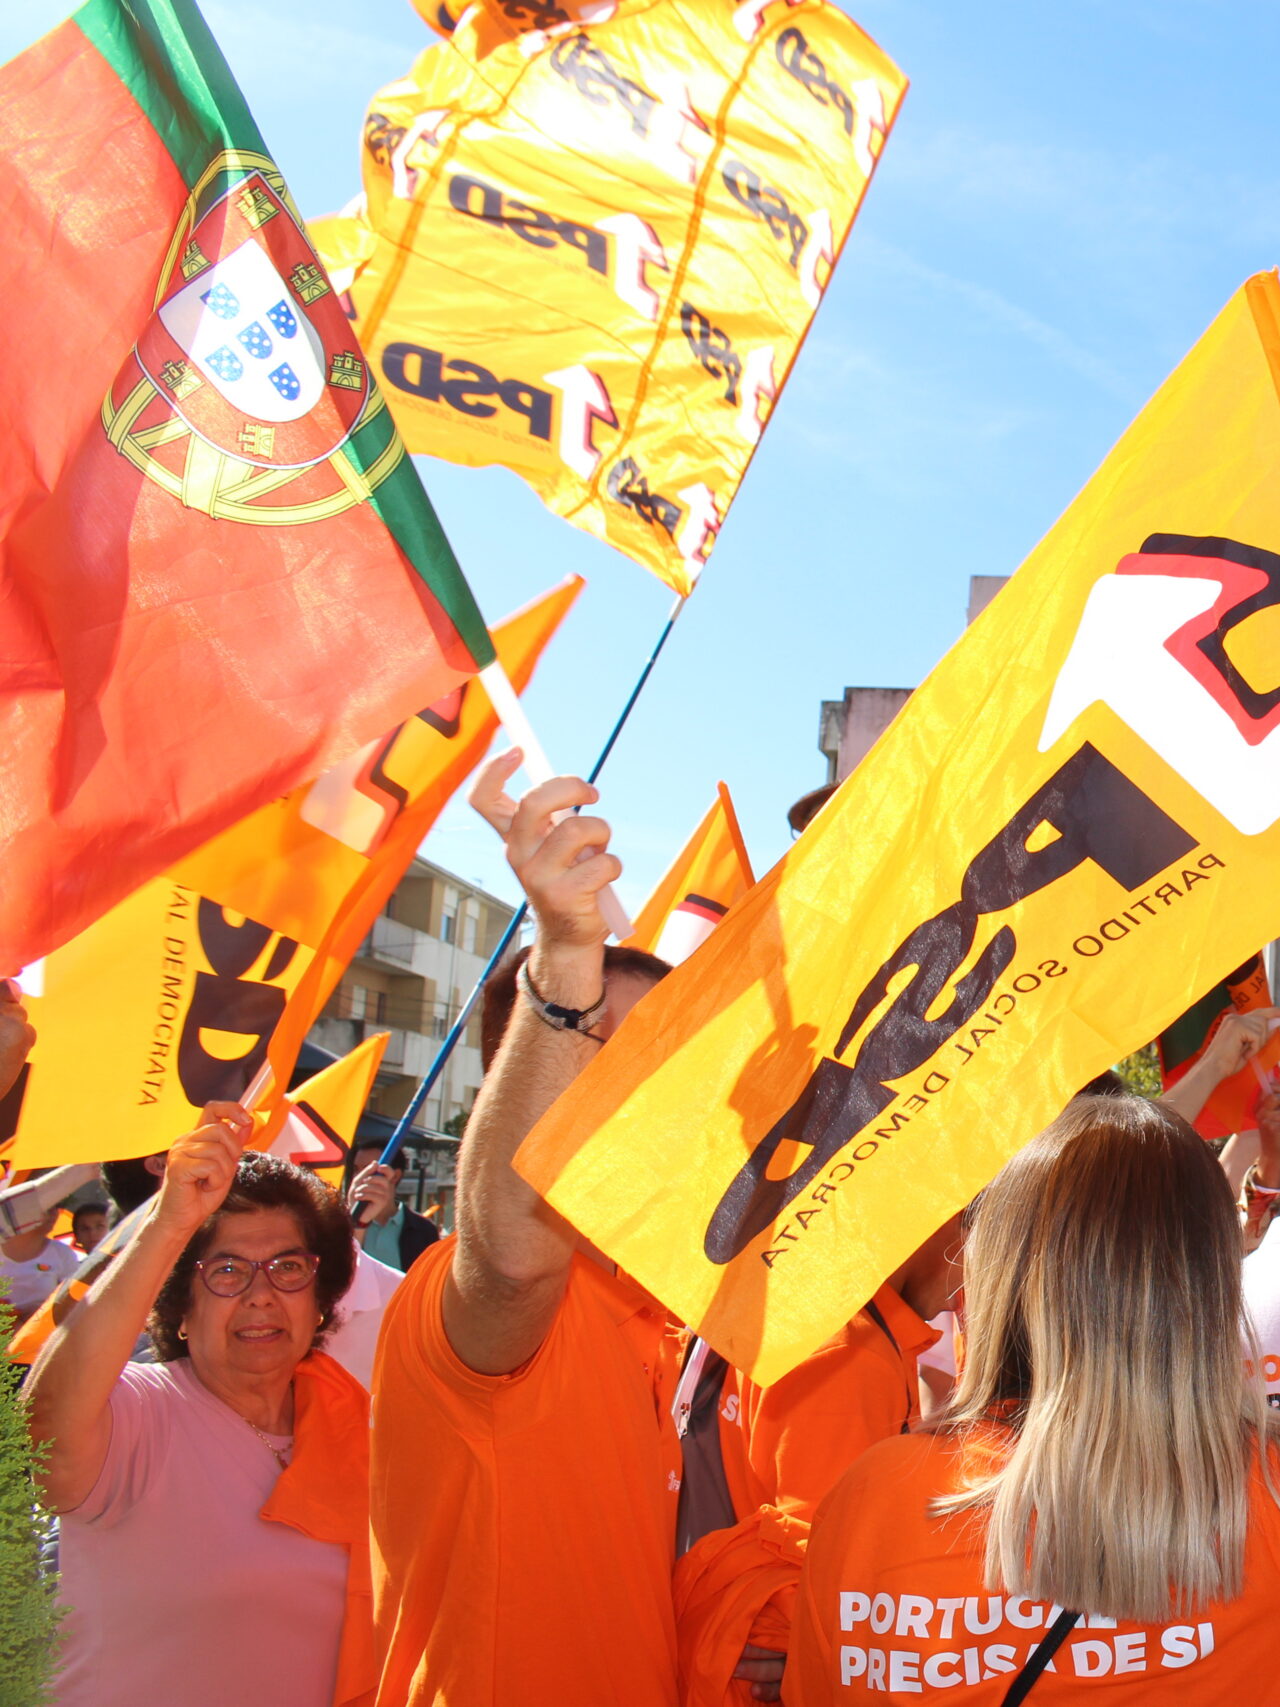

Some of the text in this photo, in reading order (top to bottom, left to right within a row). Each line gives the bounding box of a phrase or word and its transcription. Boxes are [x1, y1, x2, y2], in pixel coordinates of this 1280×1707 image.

[137, 935, 188, 1107] DEMOCRATA
[1071, 1632, 1147, 1678] DE
[1160, 1622, 1214, 1669] SI
